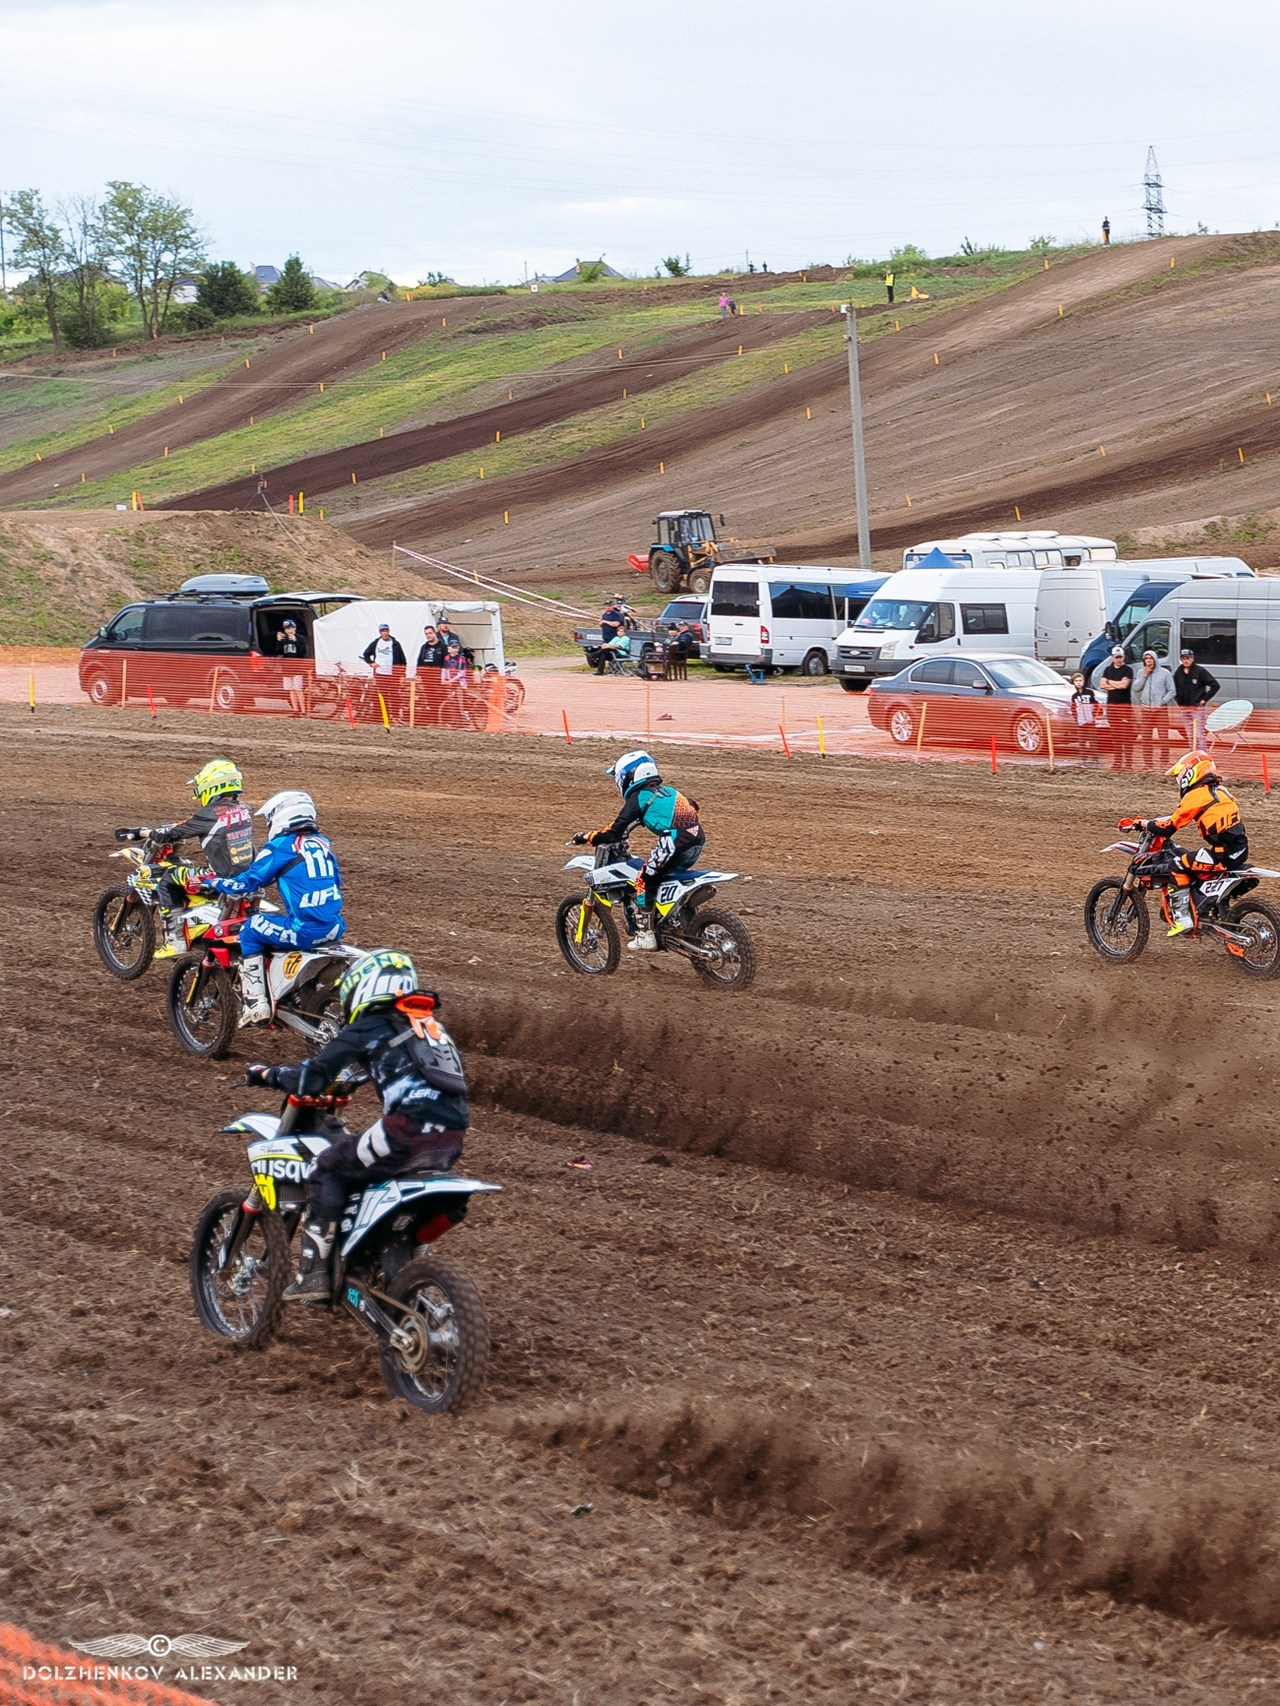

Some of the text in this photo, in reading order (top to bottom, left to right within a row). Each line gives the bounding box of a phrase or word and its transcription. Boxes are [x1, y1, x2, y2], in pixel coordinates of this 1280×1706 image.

[661, 885, 678, 903] 20
[1205, 880, 1225, 894] 227
[251, 1158, 318, 1183] Husqv
